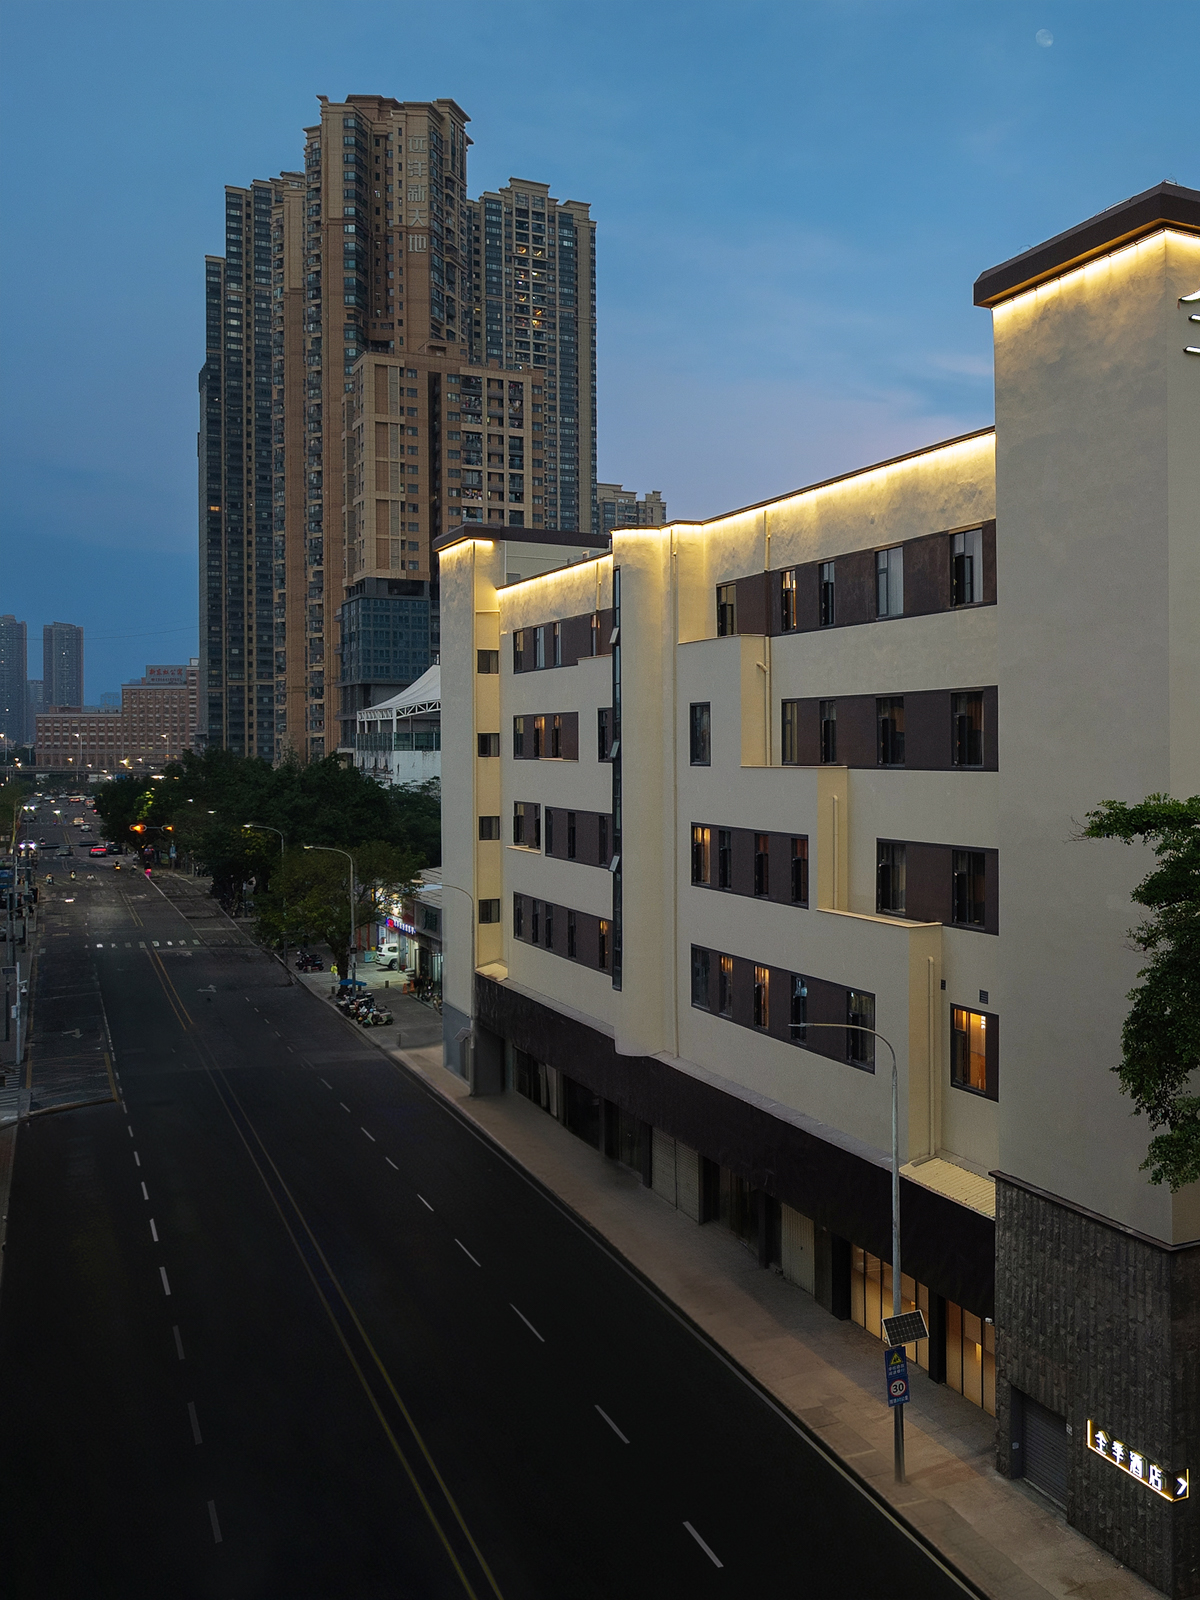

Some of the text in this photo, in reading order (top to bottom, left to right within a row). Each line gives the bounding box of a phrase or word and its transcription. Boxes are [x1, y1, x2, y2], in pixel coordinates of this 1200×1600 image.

[408, 134, 427, 253] 远洋新天地
[892, 1382, 904, 1394] 30
[1094, 1430, 1165, 1491] 全季酒店
